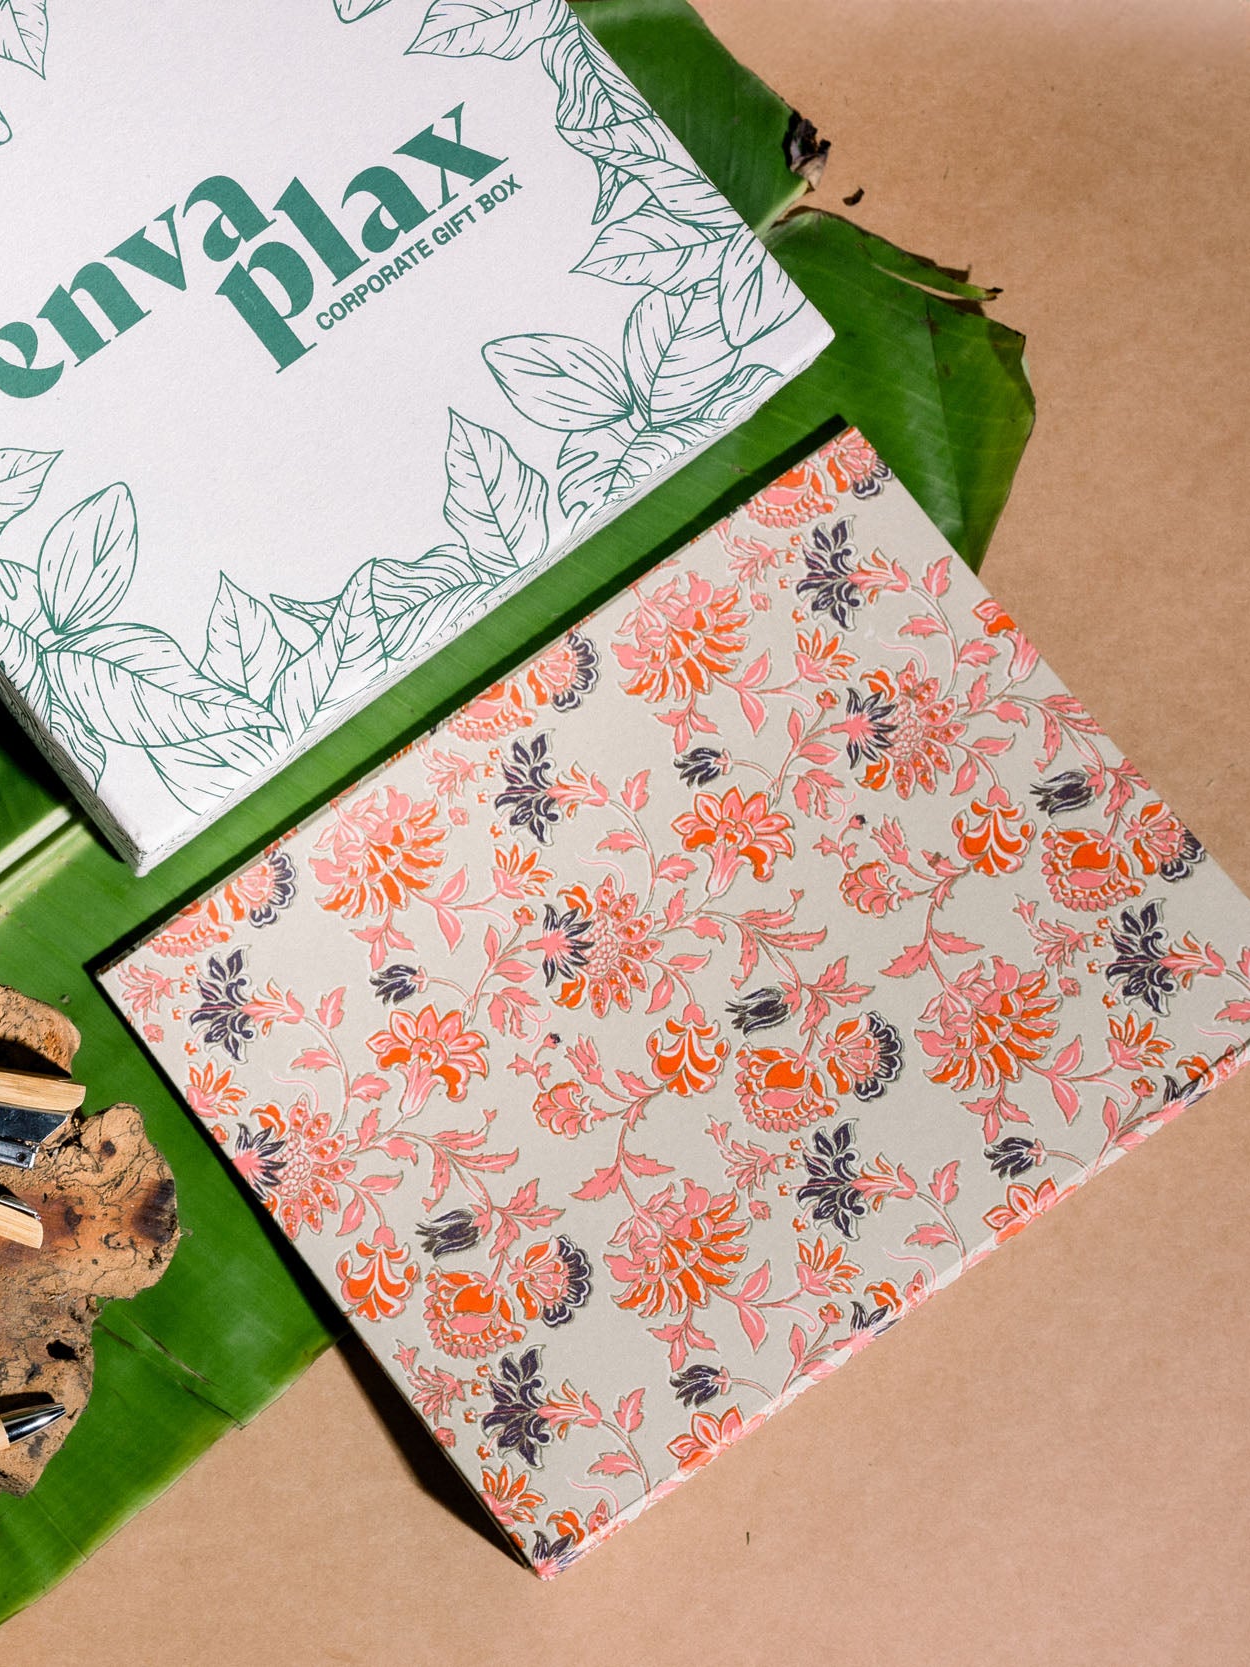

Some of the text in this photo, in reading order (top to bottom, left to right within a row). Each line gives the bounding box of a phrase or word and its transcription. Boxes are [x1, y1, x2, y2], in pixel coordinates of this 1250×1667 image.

[215, 101, 510, 374] plax
[315, 173, 523, 331] CORPORATE GIFT BOX
